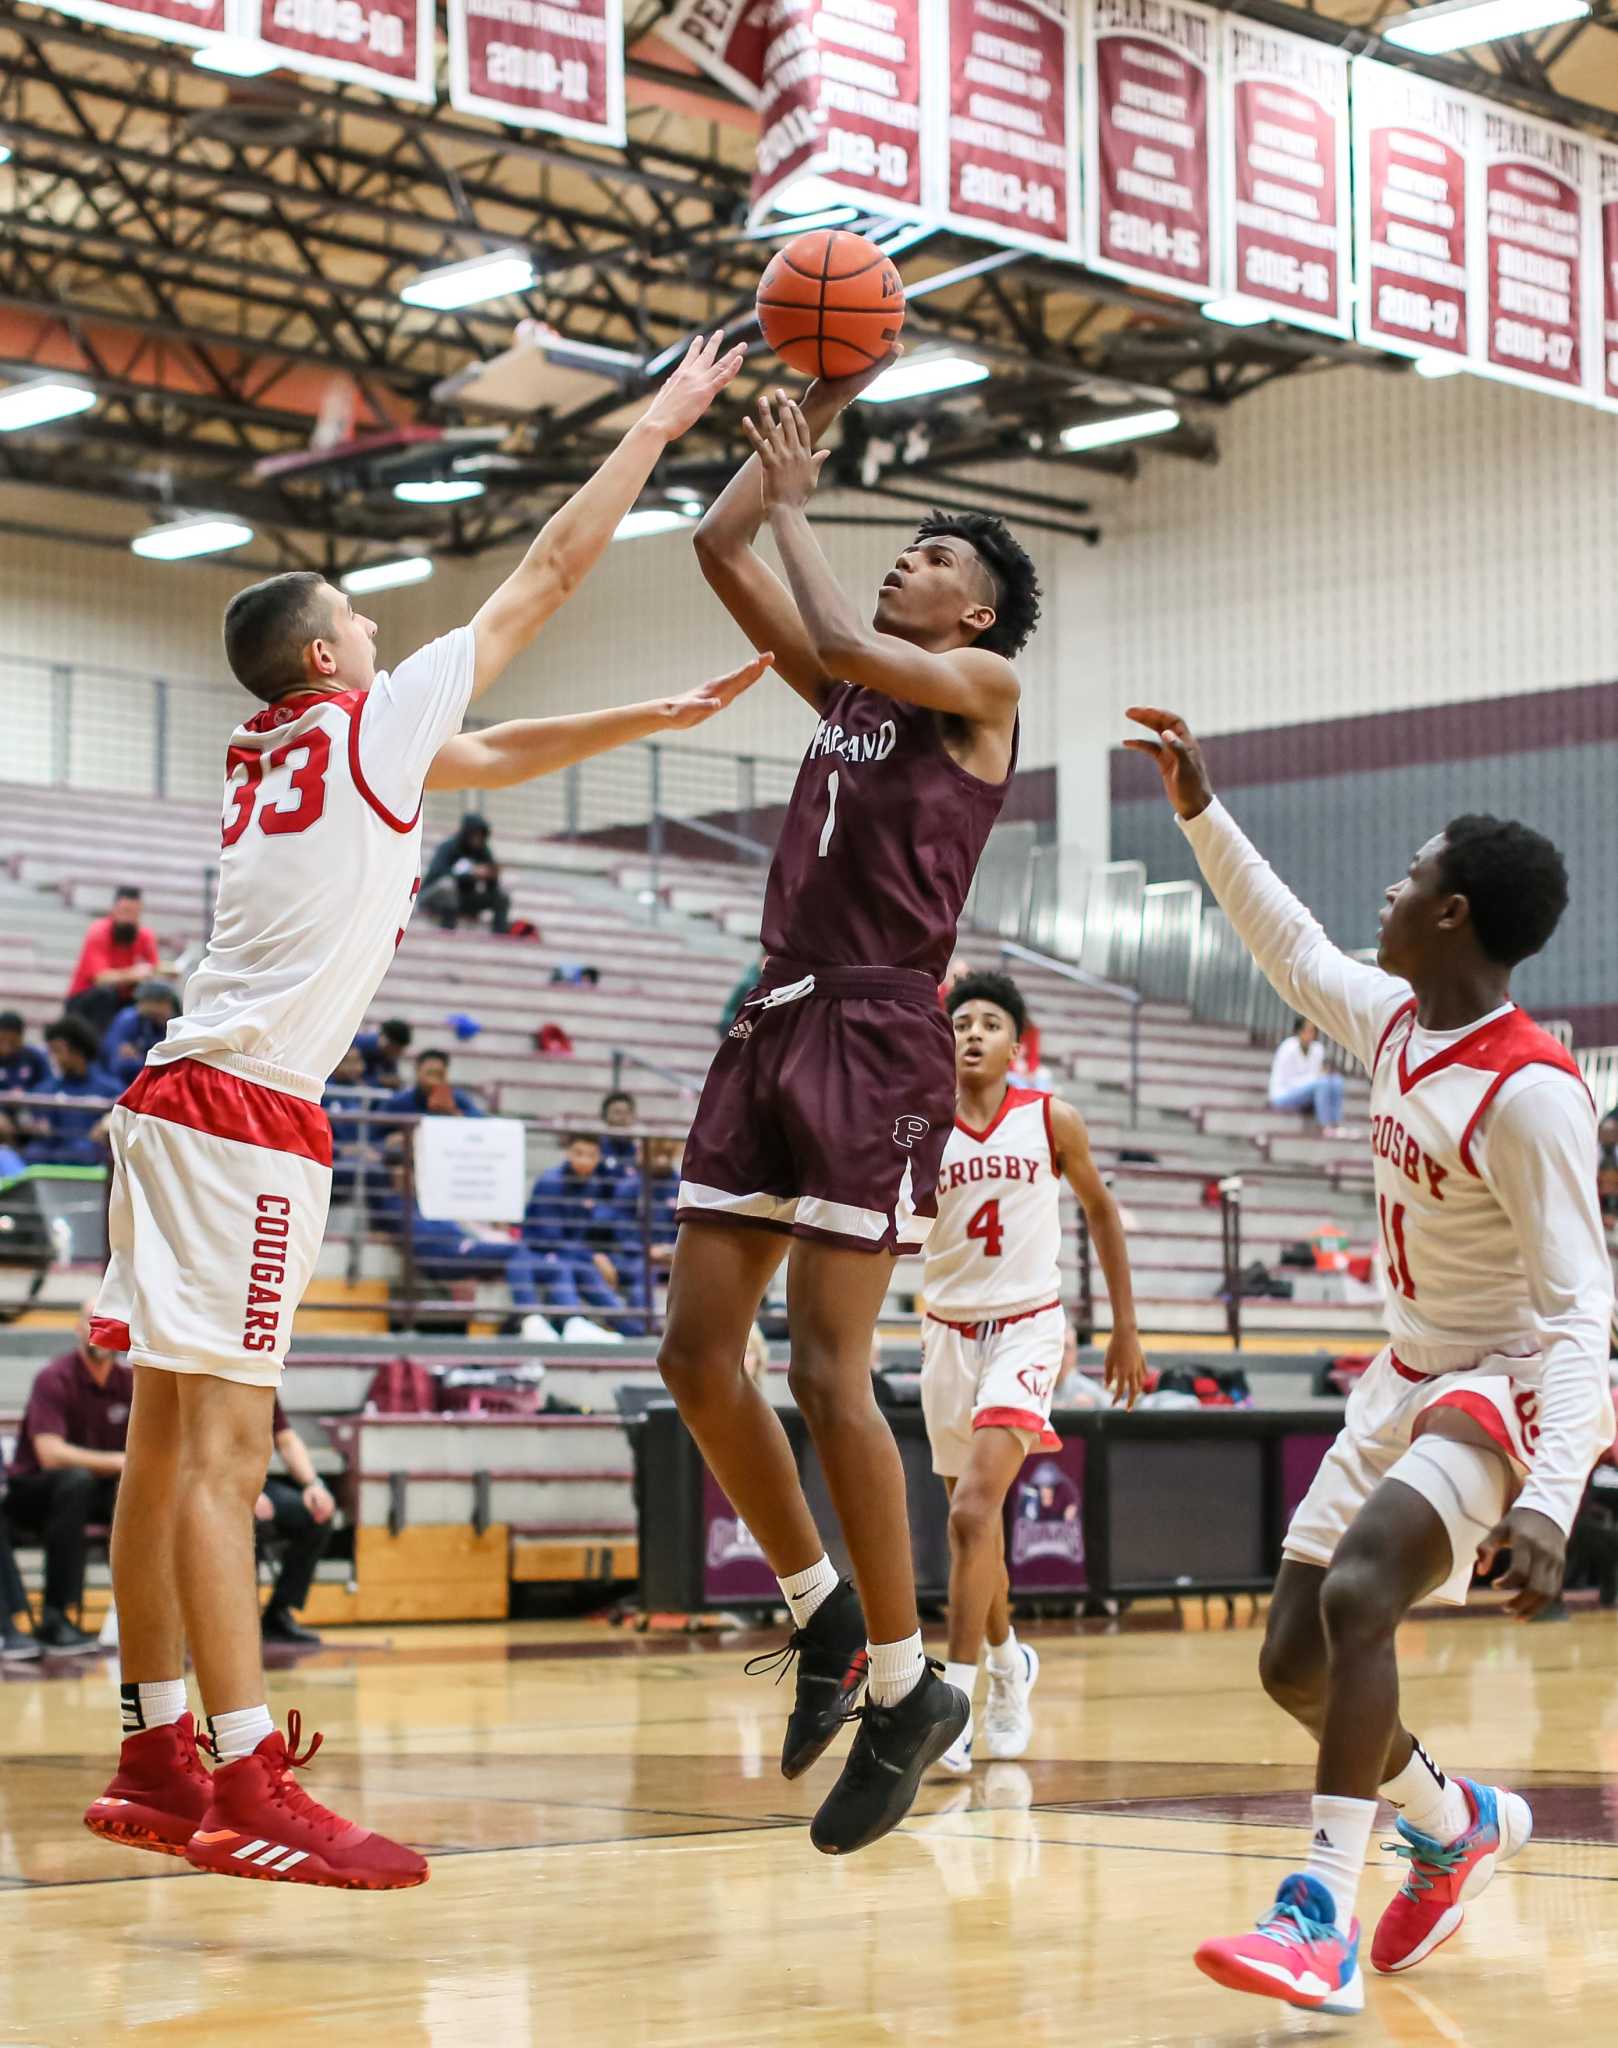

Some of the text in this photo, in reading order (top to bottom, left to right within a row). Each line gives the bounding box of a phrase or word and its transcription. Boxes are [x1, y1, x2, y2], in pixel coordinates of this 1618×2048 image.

[221, 726, 332, 849] 33
[817, 769, 839, 857] 1
[892, 1114, 930, 1149] P
[938, 1155, 1040, 1195] CROSBY
[1370, 1114, 1449, 1201] ROSBY
[966, 1198, 1004, 1257] 4
[1380, 1193, 1417, 1301] 11
[242, 1193, 291, 1353] COUGARS
